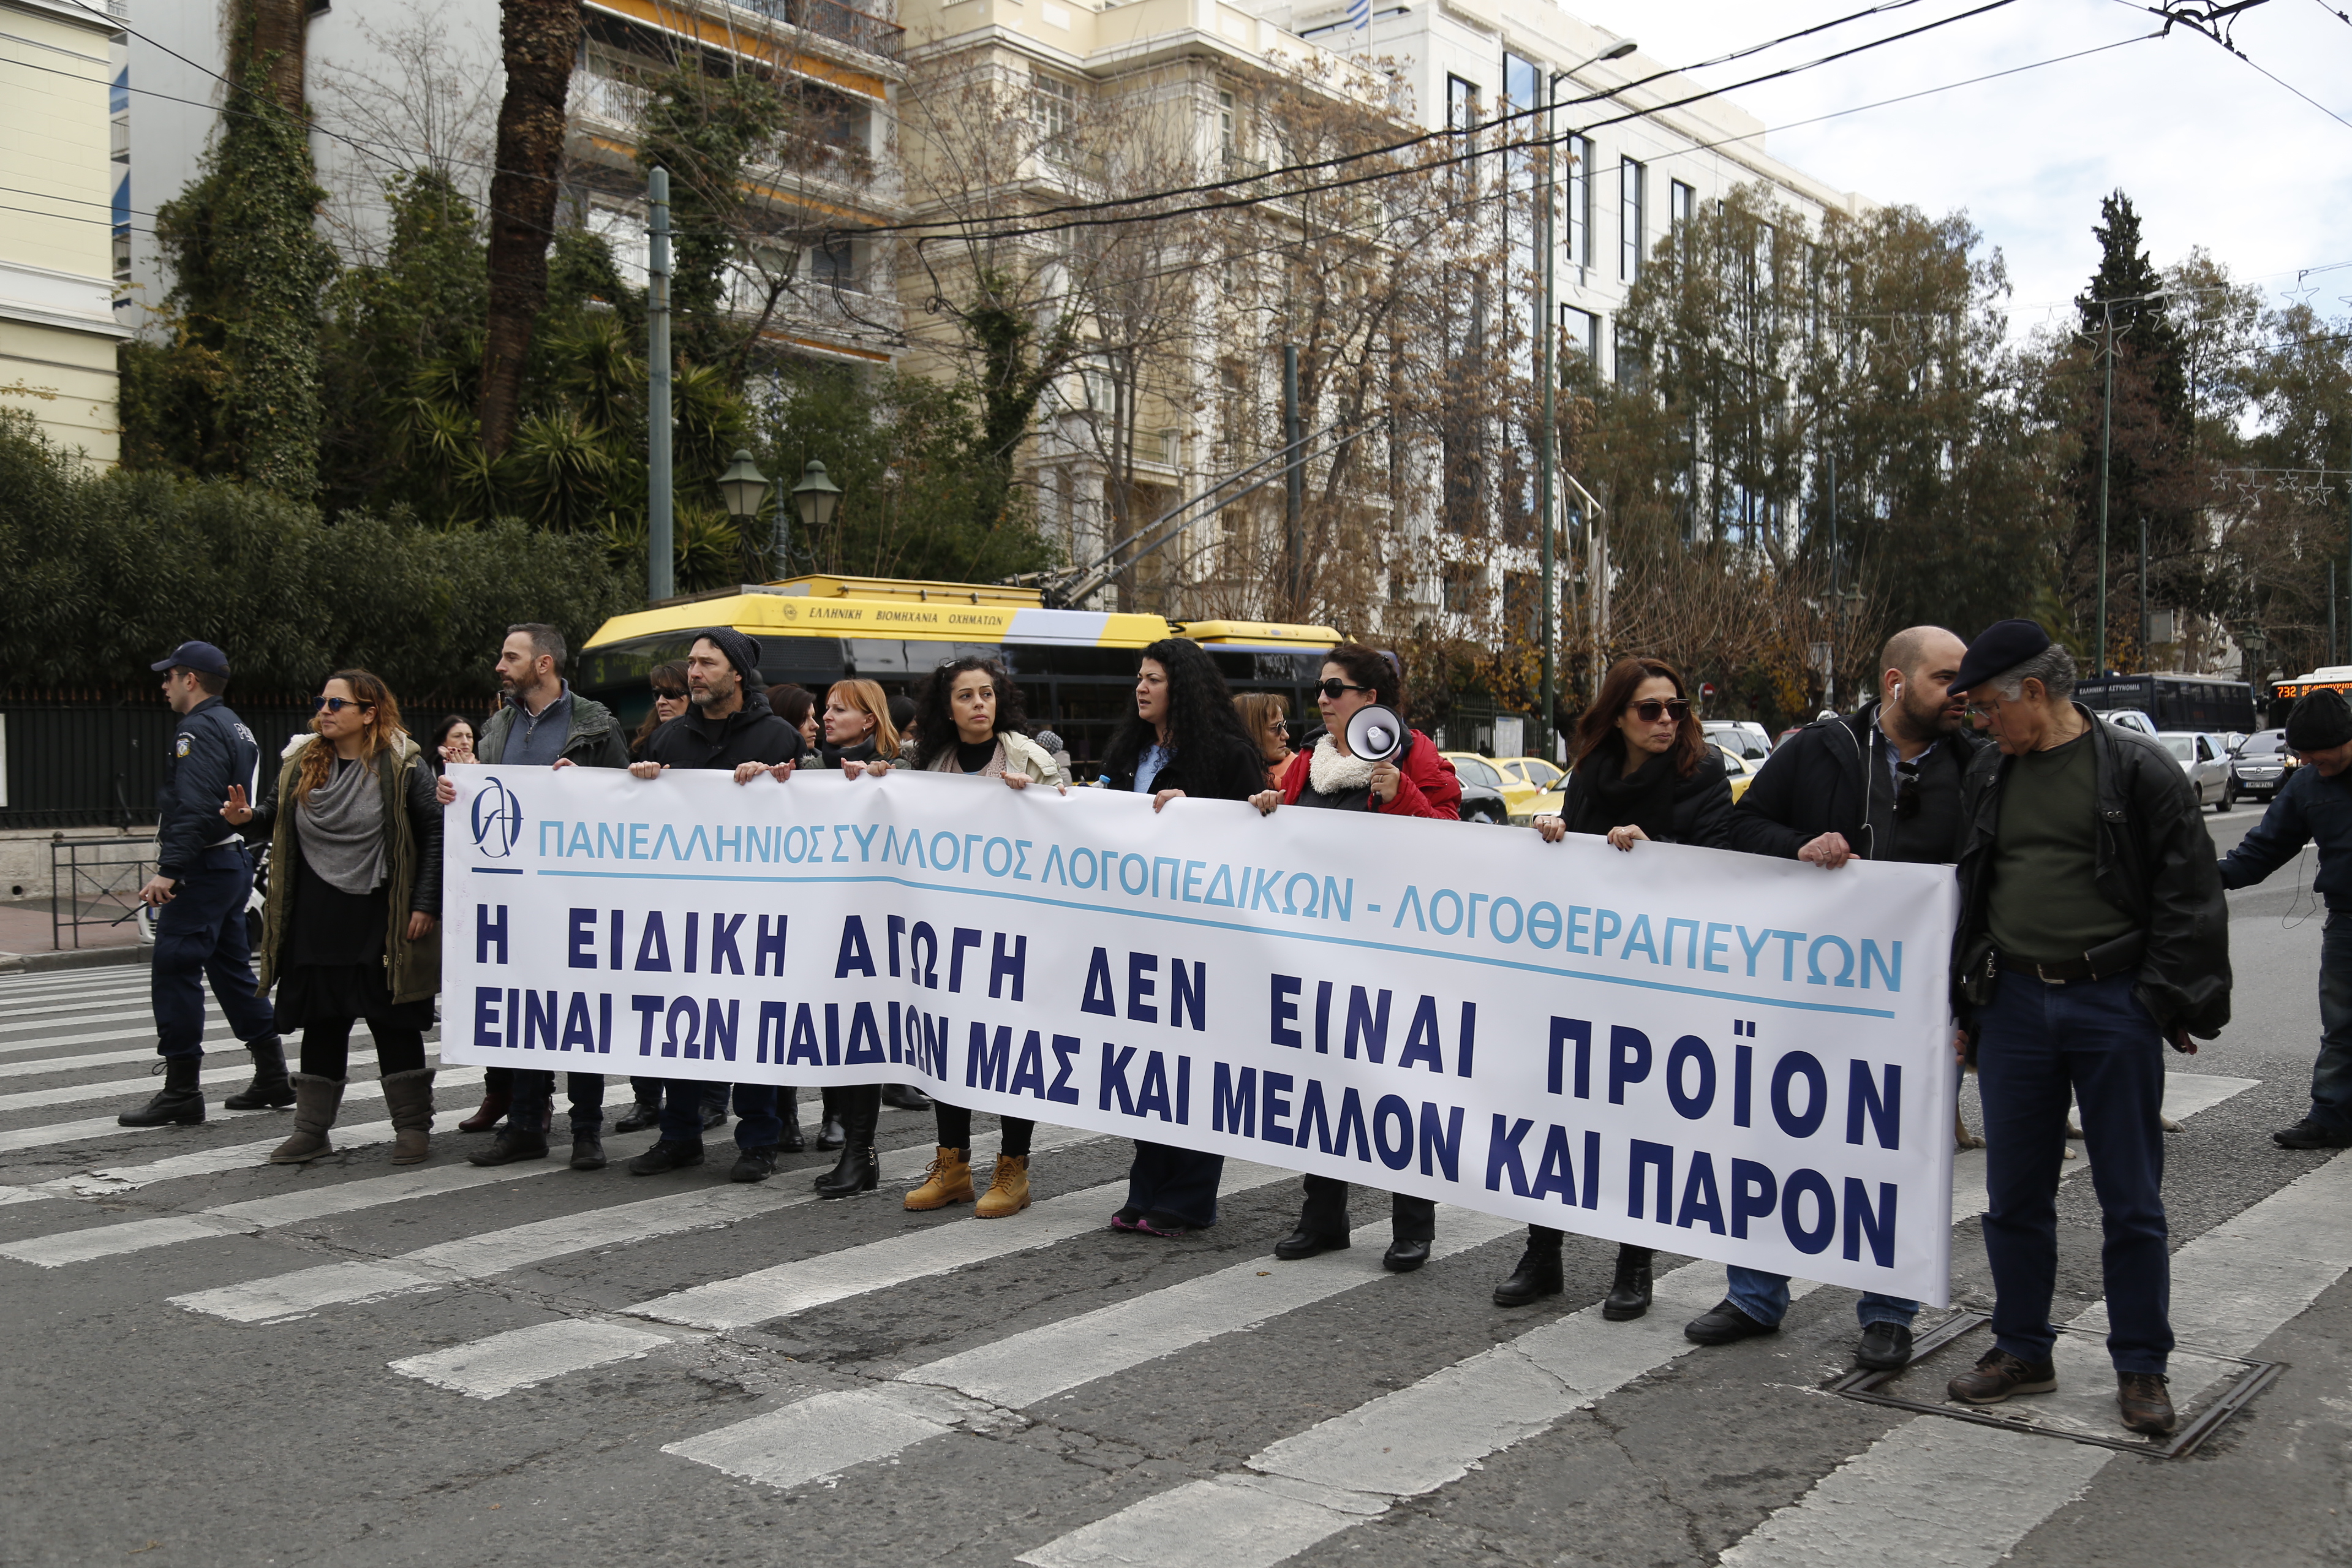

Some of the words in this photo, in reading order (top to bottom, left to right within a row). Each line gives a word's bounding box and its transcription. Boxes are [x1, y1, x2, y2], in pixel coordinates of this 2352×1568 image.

[809, 607, 862, 619] ΕΛΛΗΝΙΚΗ
[876, 610, 938, 622] ΒΙΟΜΗΧΑΝΙΑ
[949, 614, 1003, 625] ΟΧΗΜΑΤΩΝ
[595, 658, 605, 684] 3
[2108, 684, 2140, 692] ΑΣΤΥΝΟΜΙΑ
[2277, 685, 2297, 698] 732
[540, 820, 825, 864] ΠΑΝΕΛΛΗΝΙΟΣ
[832, 824, 1033, 881] ΣΥΛΛΟΓΟΣ
[1041, 844, 1354, 922] ΛΟΓΟΠΕΔΙΚΩΝ
[1393, 885, 1902, 992] ΛΟΓΟΘΕΡΑΠΕΥΤΩΝ
[477, 903, 508, 965] Η
[569, 908, 788, 977] ΕΙΔΙΚΗ
[835, 914, 1027, 1002] ΑΓΩΓΗ
[1080, 946, 1206, 1031] ΔΕΝ
[1271, 973, 1476, 1078] ΕΙΝΑΙ
[1547, 1016, 1902, 1150] ΠΡΟΪΟΝ
[474, 986, 612, 1054] ΕΙΝΑΙ
[632, 995, 740, 1061] ΤΩΝ
[757, 1001, 949, 1081] ΠΑΙΔΙΩΝ
[966, 1022, 1081, 1105] ΜΑΣ
[1099, 1042, 1191, 1126] ΚΑΙ
[1212, 1061, 1464, 1182] ΜΕΛΛΟΝ
[1485, 1114, 1600, 1210] ΚΑΙ
[1627, 1139, 1897, 1268] ΠΑΡΟΝ
